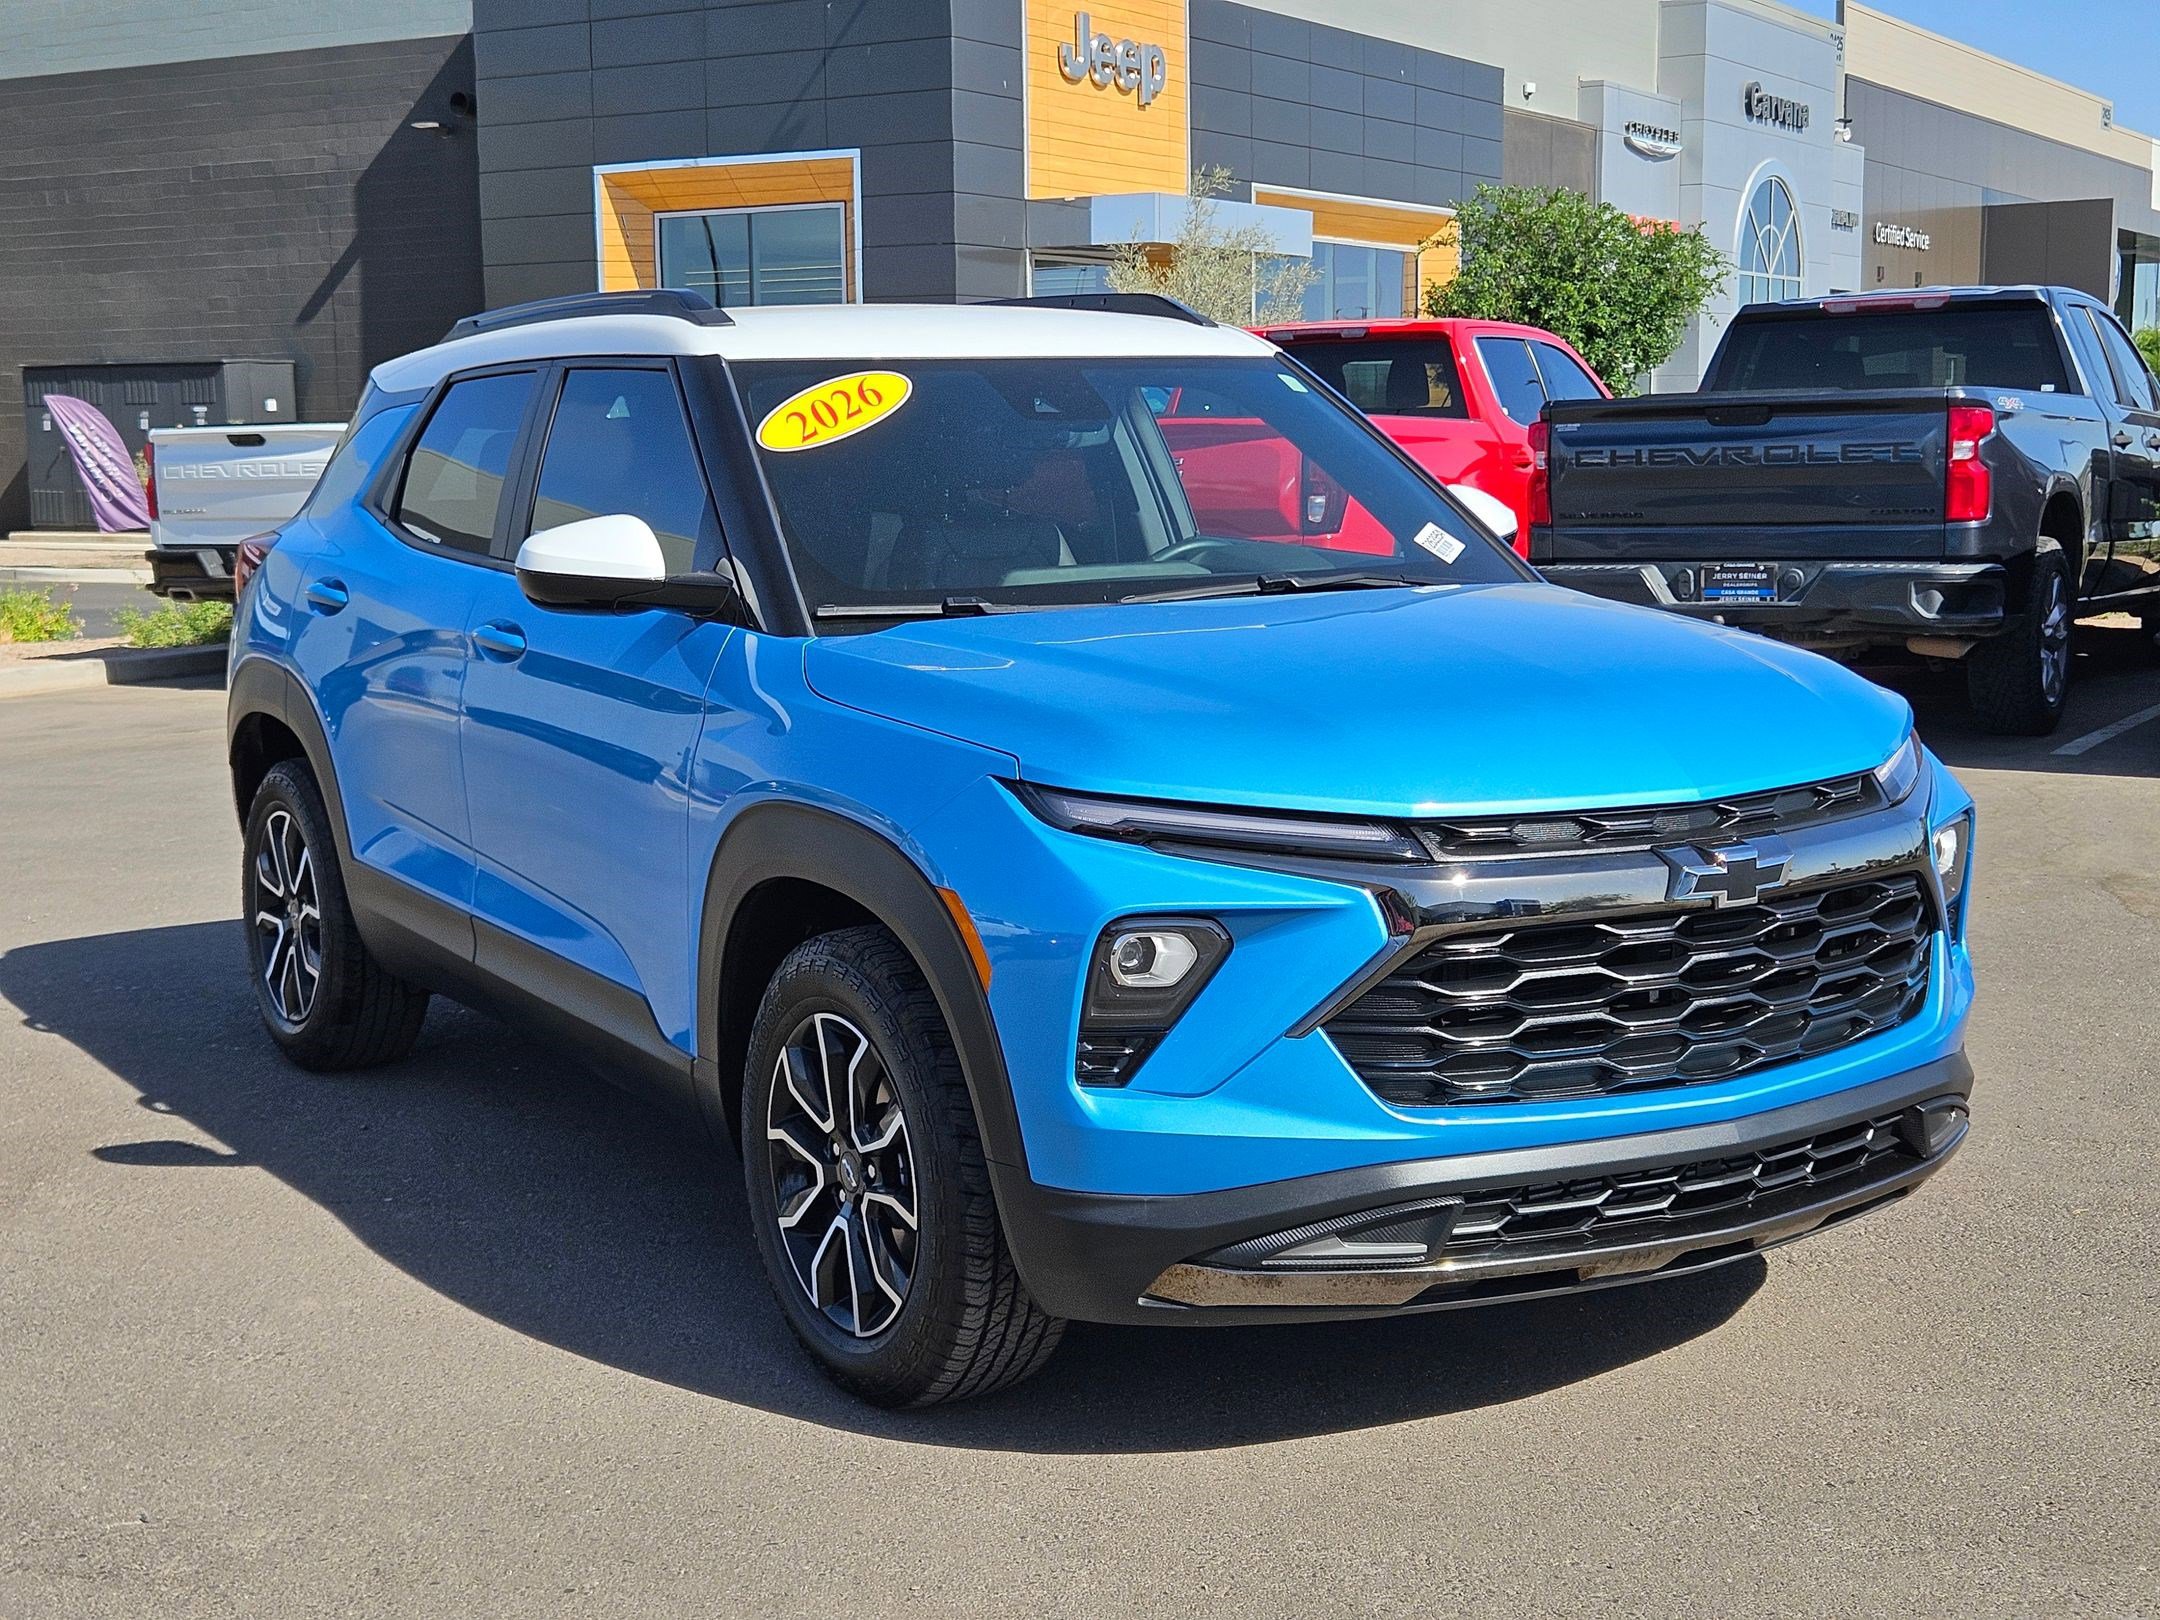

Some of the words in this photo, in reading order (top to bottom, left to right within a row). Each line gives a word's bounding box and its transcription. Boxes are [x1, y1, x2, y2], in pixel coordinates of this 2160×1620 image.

[1058, 11, 1166, 108] Jeep
[1874, 221, 1906, 247] Certified
[1905, 226, 1930, 250] Service
[786, 377, 883, 443] 2026
[1573, 441, 1922, 469] CHEVROLET
[1712, 572, 1738, 580] JERRY
[1738, 572, 1768, 580] SEINER
